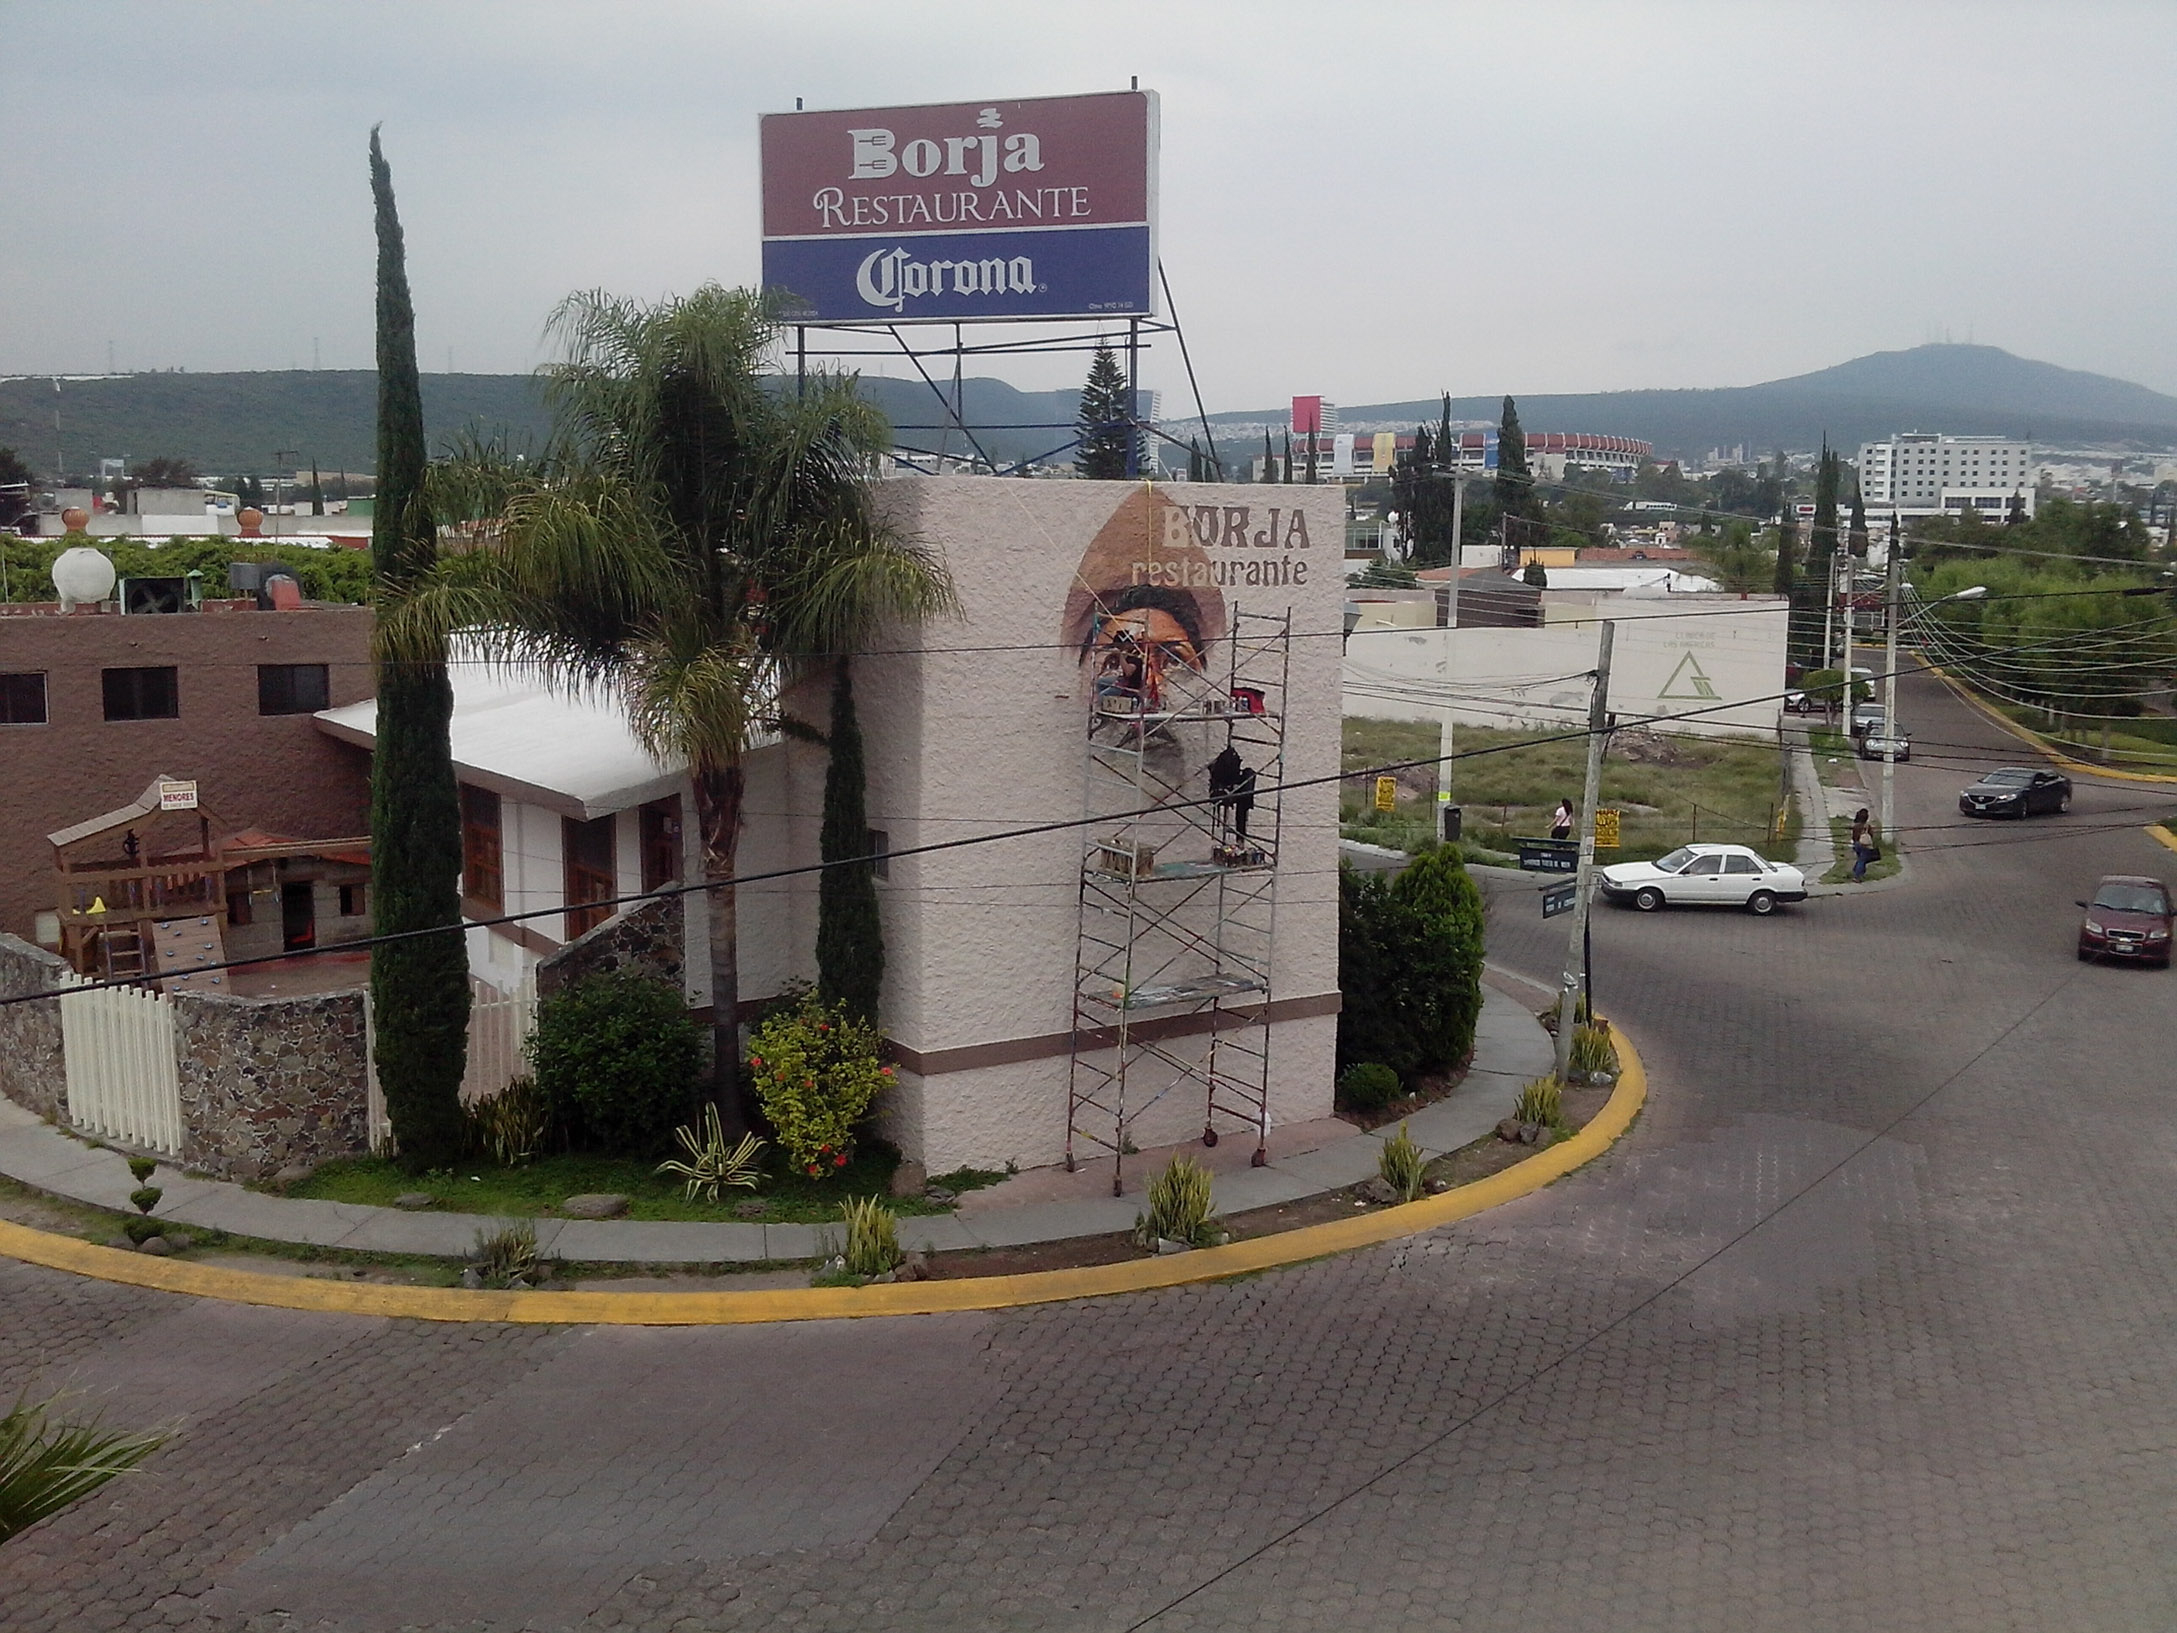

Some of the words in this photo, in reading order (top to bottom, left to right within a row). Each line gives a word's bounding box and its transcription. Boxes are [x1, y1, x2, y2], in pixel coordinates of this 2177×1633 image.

[847, 108, 1045, 188] Borja
[813, 186, 1092, 229] RESTAURANTE
[856, 246, 1037, 313] Corona
[1162, 505, 1311, 549] BORJA
[1131, 554, 1309, 587] restaurante
[163, 792, 194, 802] MENORES
